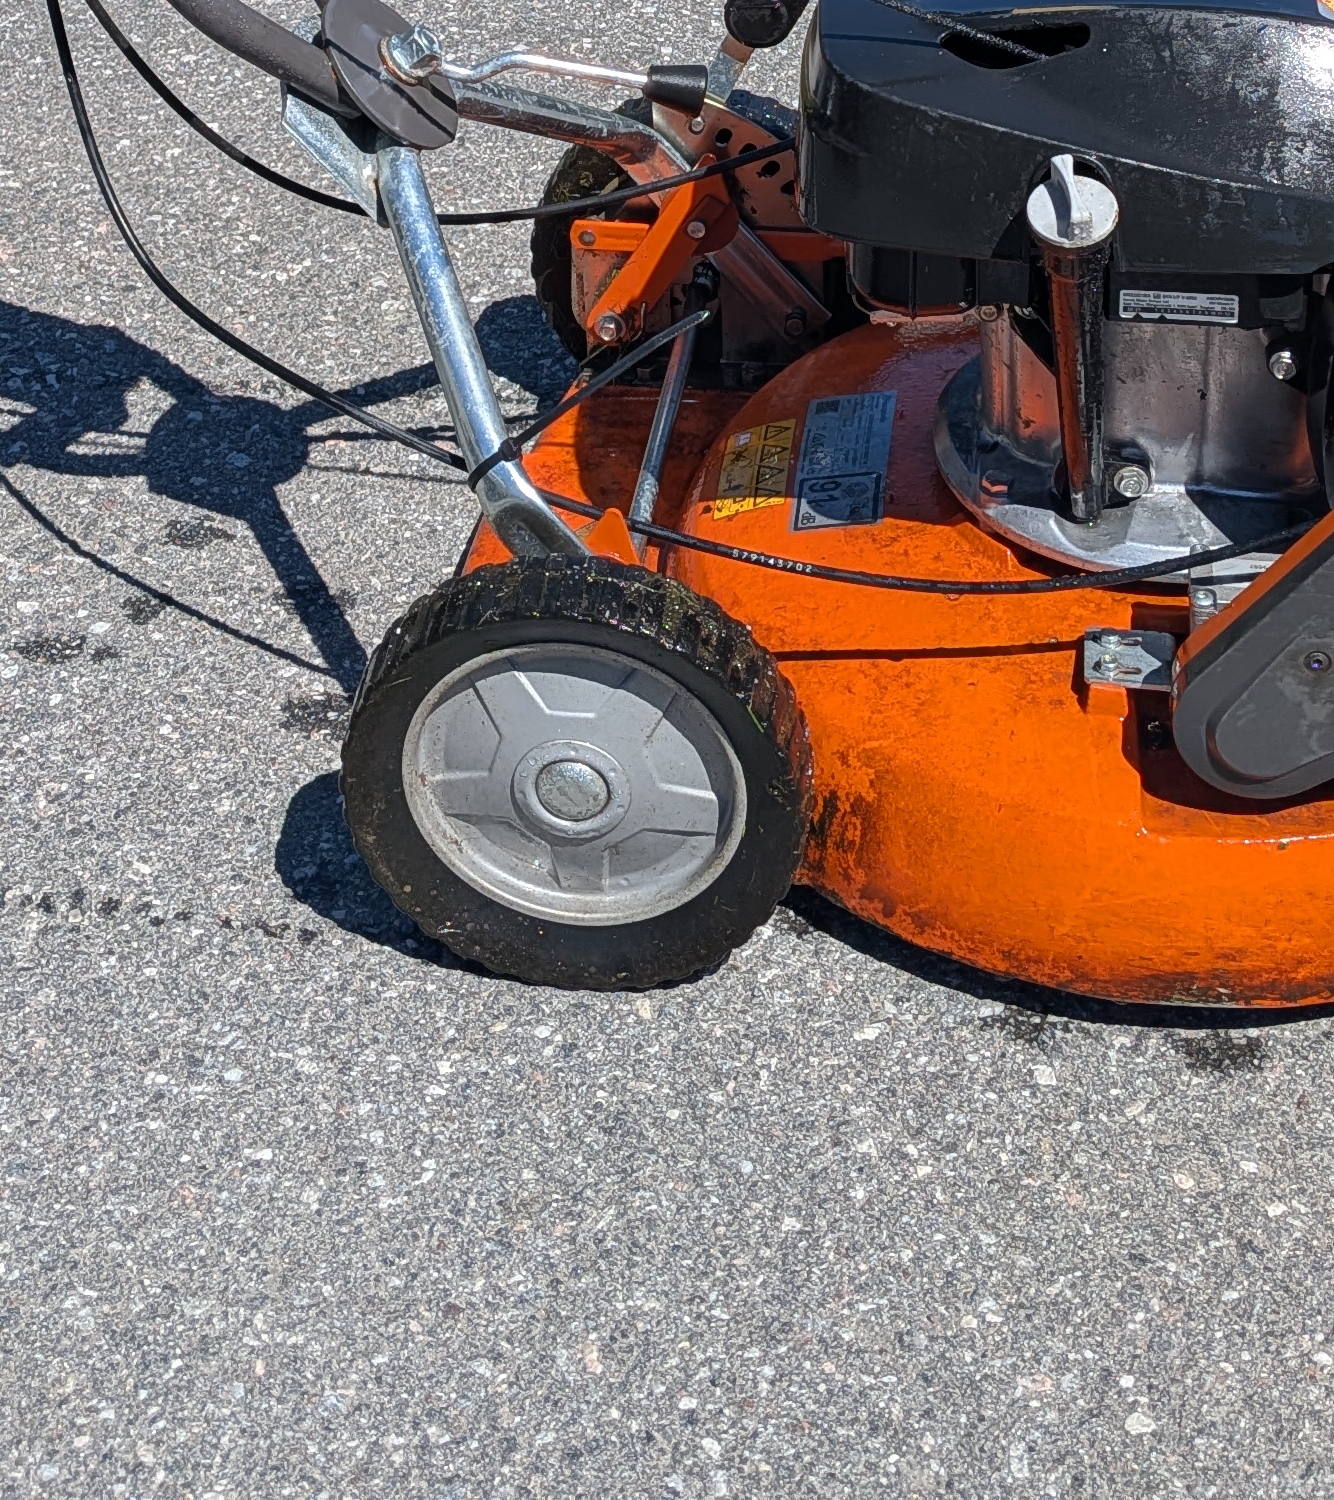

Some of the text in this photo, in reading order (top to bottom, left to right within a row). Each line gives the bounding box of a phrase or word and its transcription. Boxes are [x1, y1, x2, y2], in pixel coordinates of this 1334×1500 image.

[807, 480, 842, 505] 91
[800, 511, 816, 525] dB
[732, 548, 813, 573] 579143702
